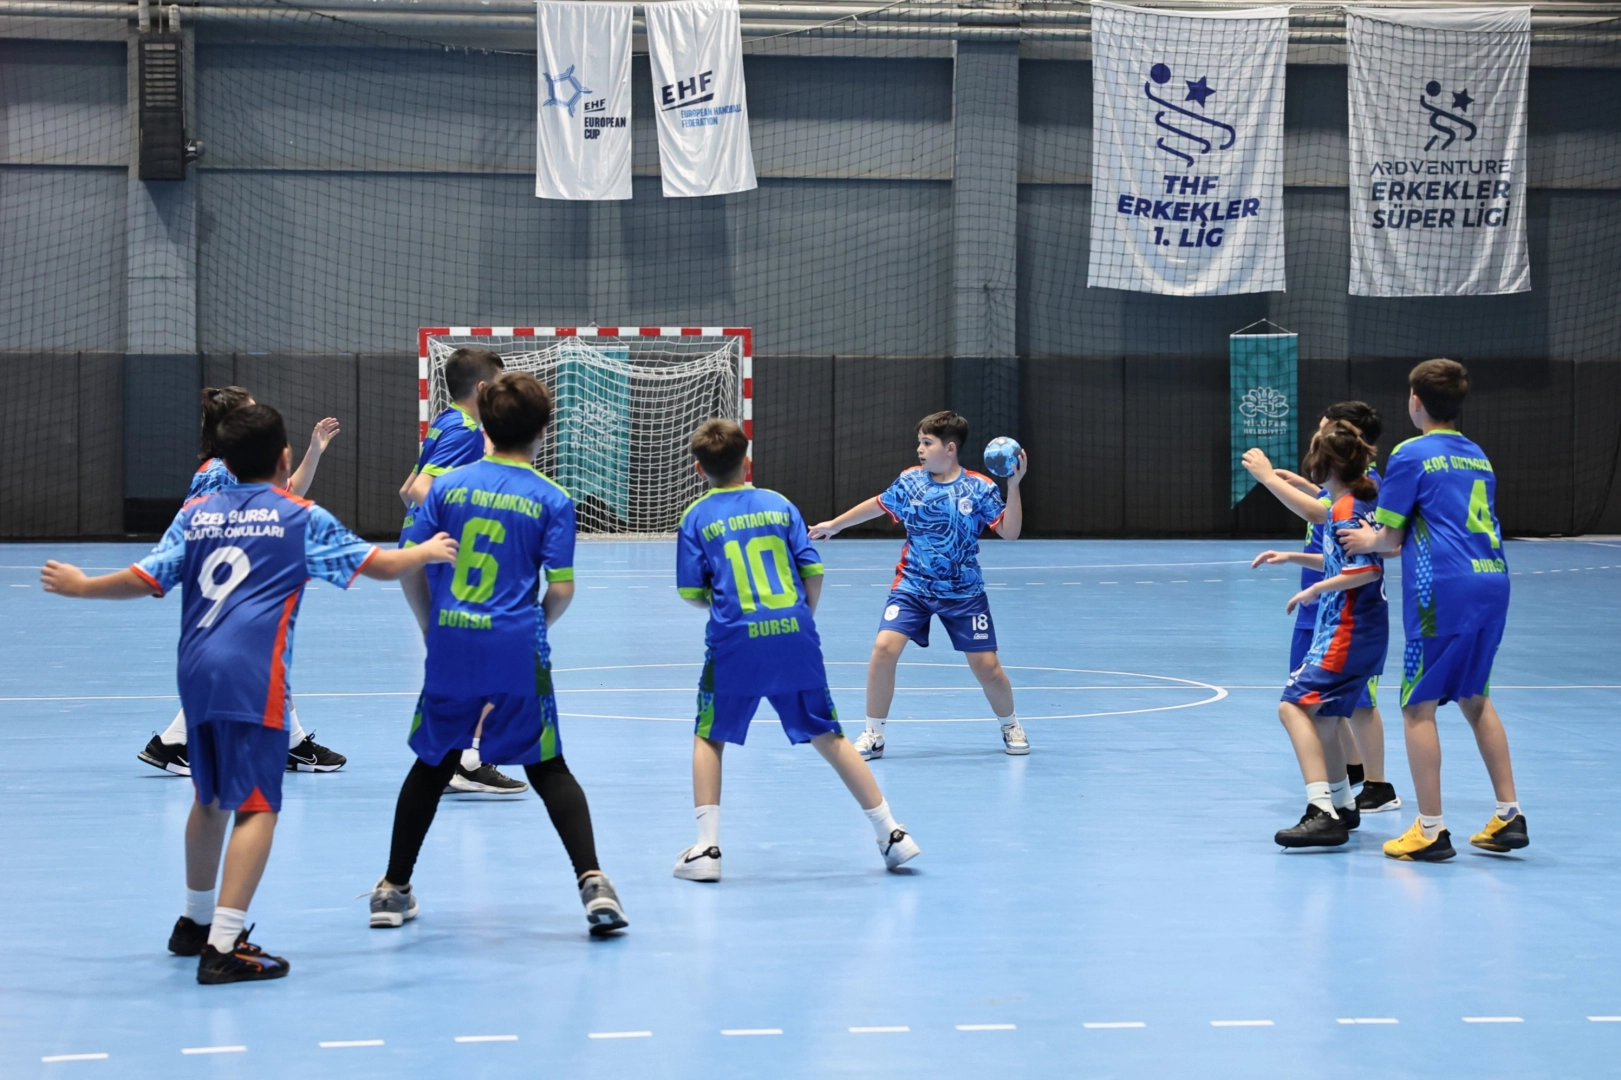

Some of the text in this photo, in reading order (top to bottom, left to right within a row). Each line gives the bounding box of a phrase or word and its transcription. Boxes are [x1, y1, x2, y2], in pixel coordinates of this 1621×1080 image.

[661, 70, 713, 105] EHF
[584, 99, 606, 111] EHF
[680, 107, 713, 119] EUROPEAN
[584, 117, 626, 128] EUROPEAN
[681, 116, 719, 128] FEDERATION
[584, 129, 601, 140] CUP
[1163, 174, 1220, 195] THF
[1371, 179, 1511, 201] ERKEKLER
[1117, 193, 1260, 222] ERKEKLER
[1371, 200, 1511, 229] SÜPER LİGİ
[1154, 221, 1225, 248] 1. LİG
[190, 509, 226, 527] ÖZEL
[1465, 479, 1500, 549] 4
[702, 519, 726, 542] KOÇ
[450, 516, 507, 604] 6
[723, 534, 799, 614] 10
[197, 545, 252, 629] 9
[438, 608, 493, 630] BURSA
[747, 616, 800, 638] BURSA
[972, 613, 989, 631] 18
